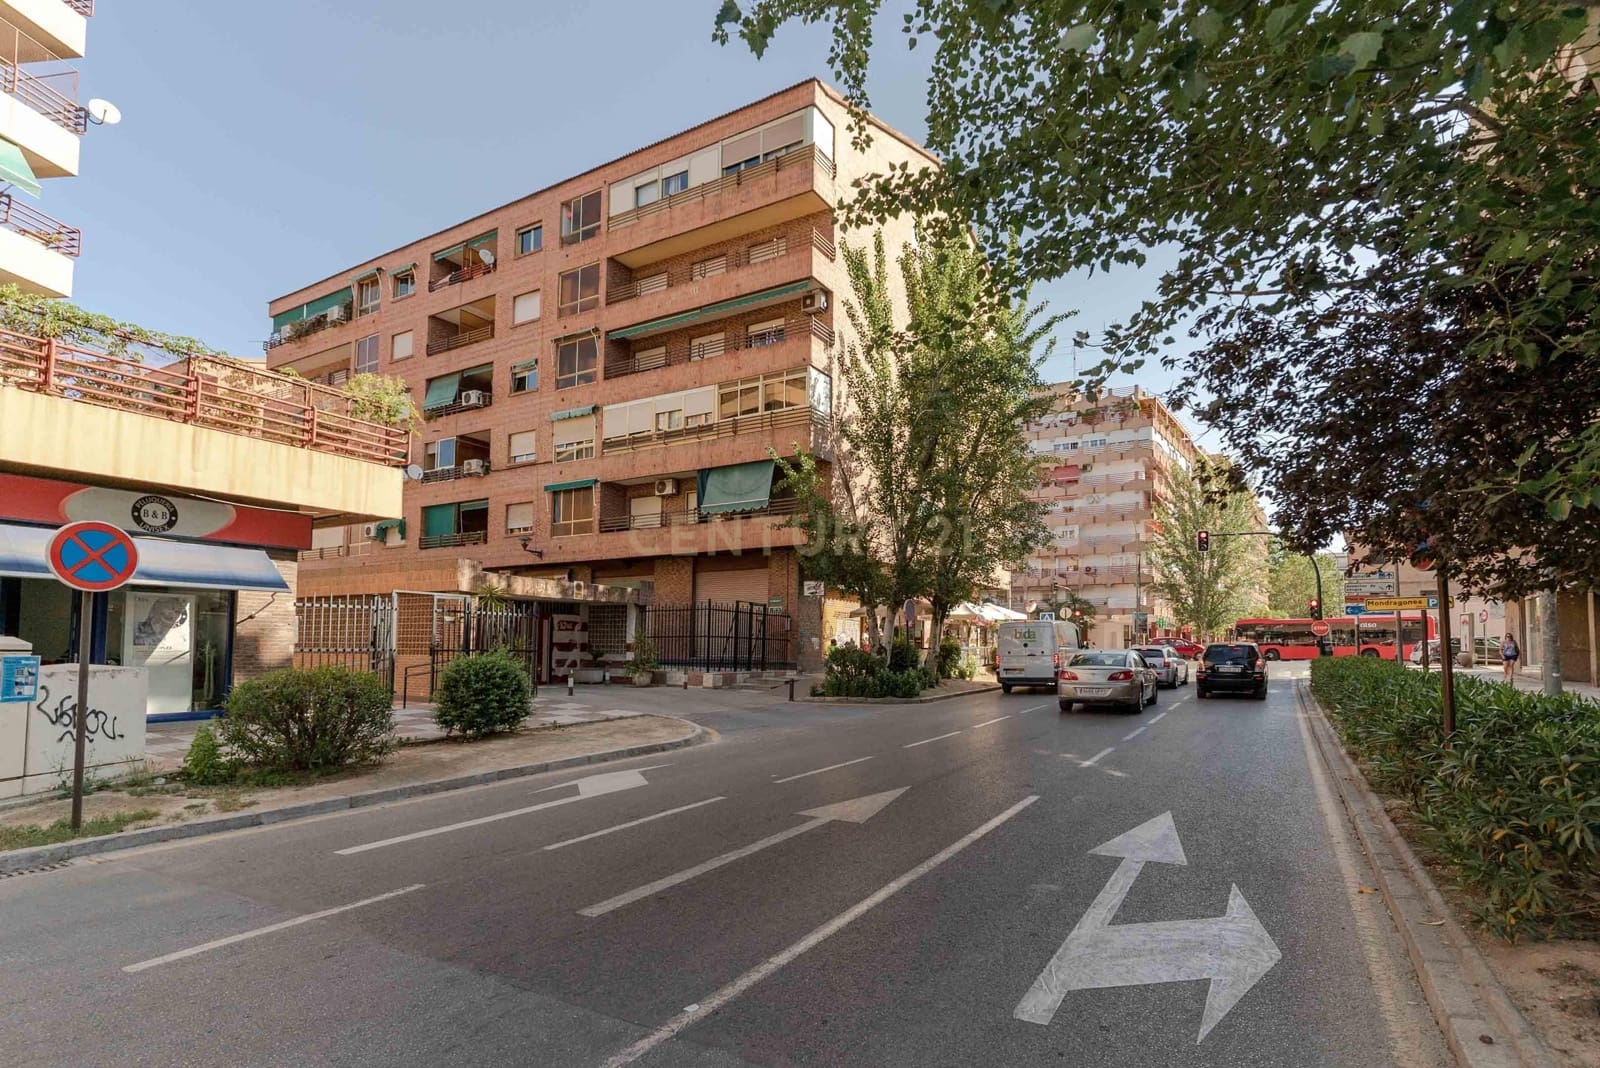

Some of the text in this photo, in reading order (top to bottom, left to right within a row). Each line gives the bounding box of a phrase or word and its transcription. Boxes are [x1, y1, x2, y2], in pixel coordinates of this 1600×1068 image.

[143, 509, 168, 520] B & B
[1367, 599, 1423, 607] Mondragones
